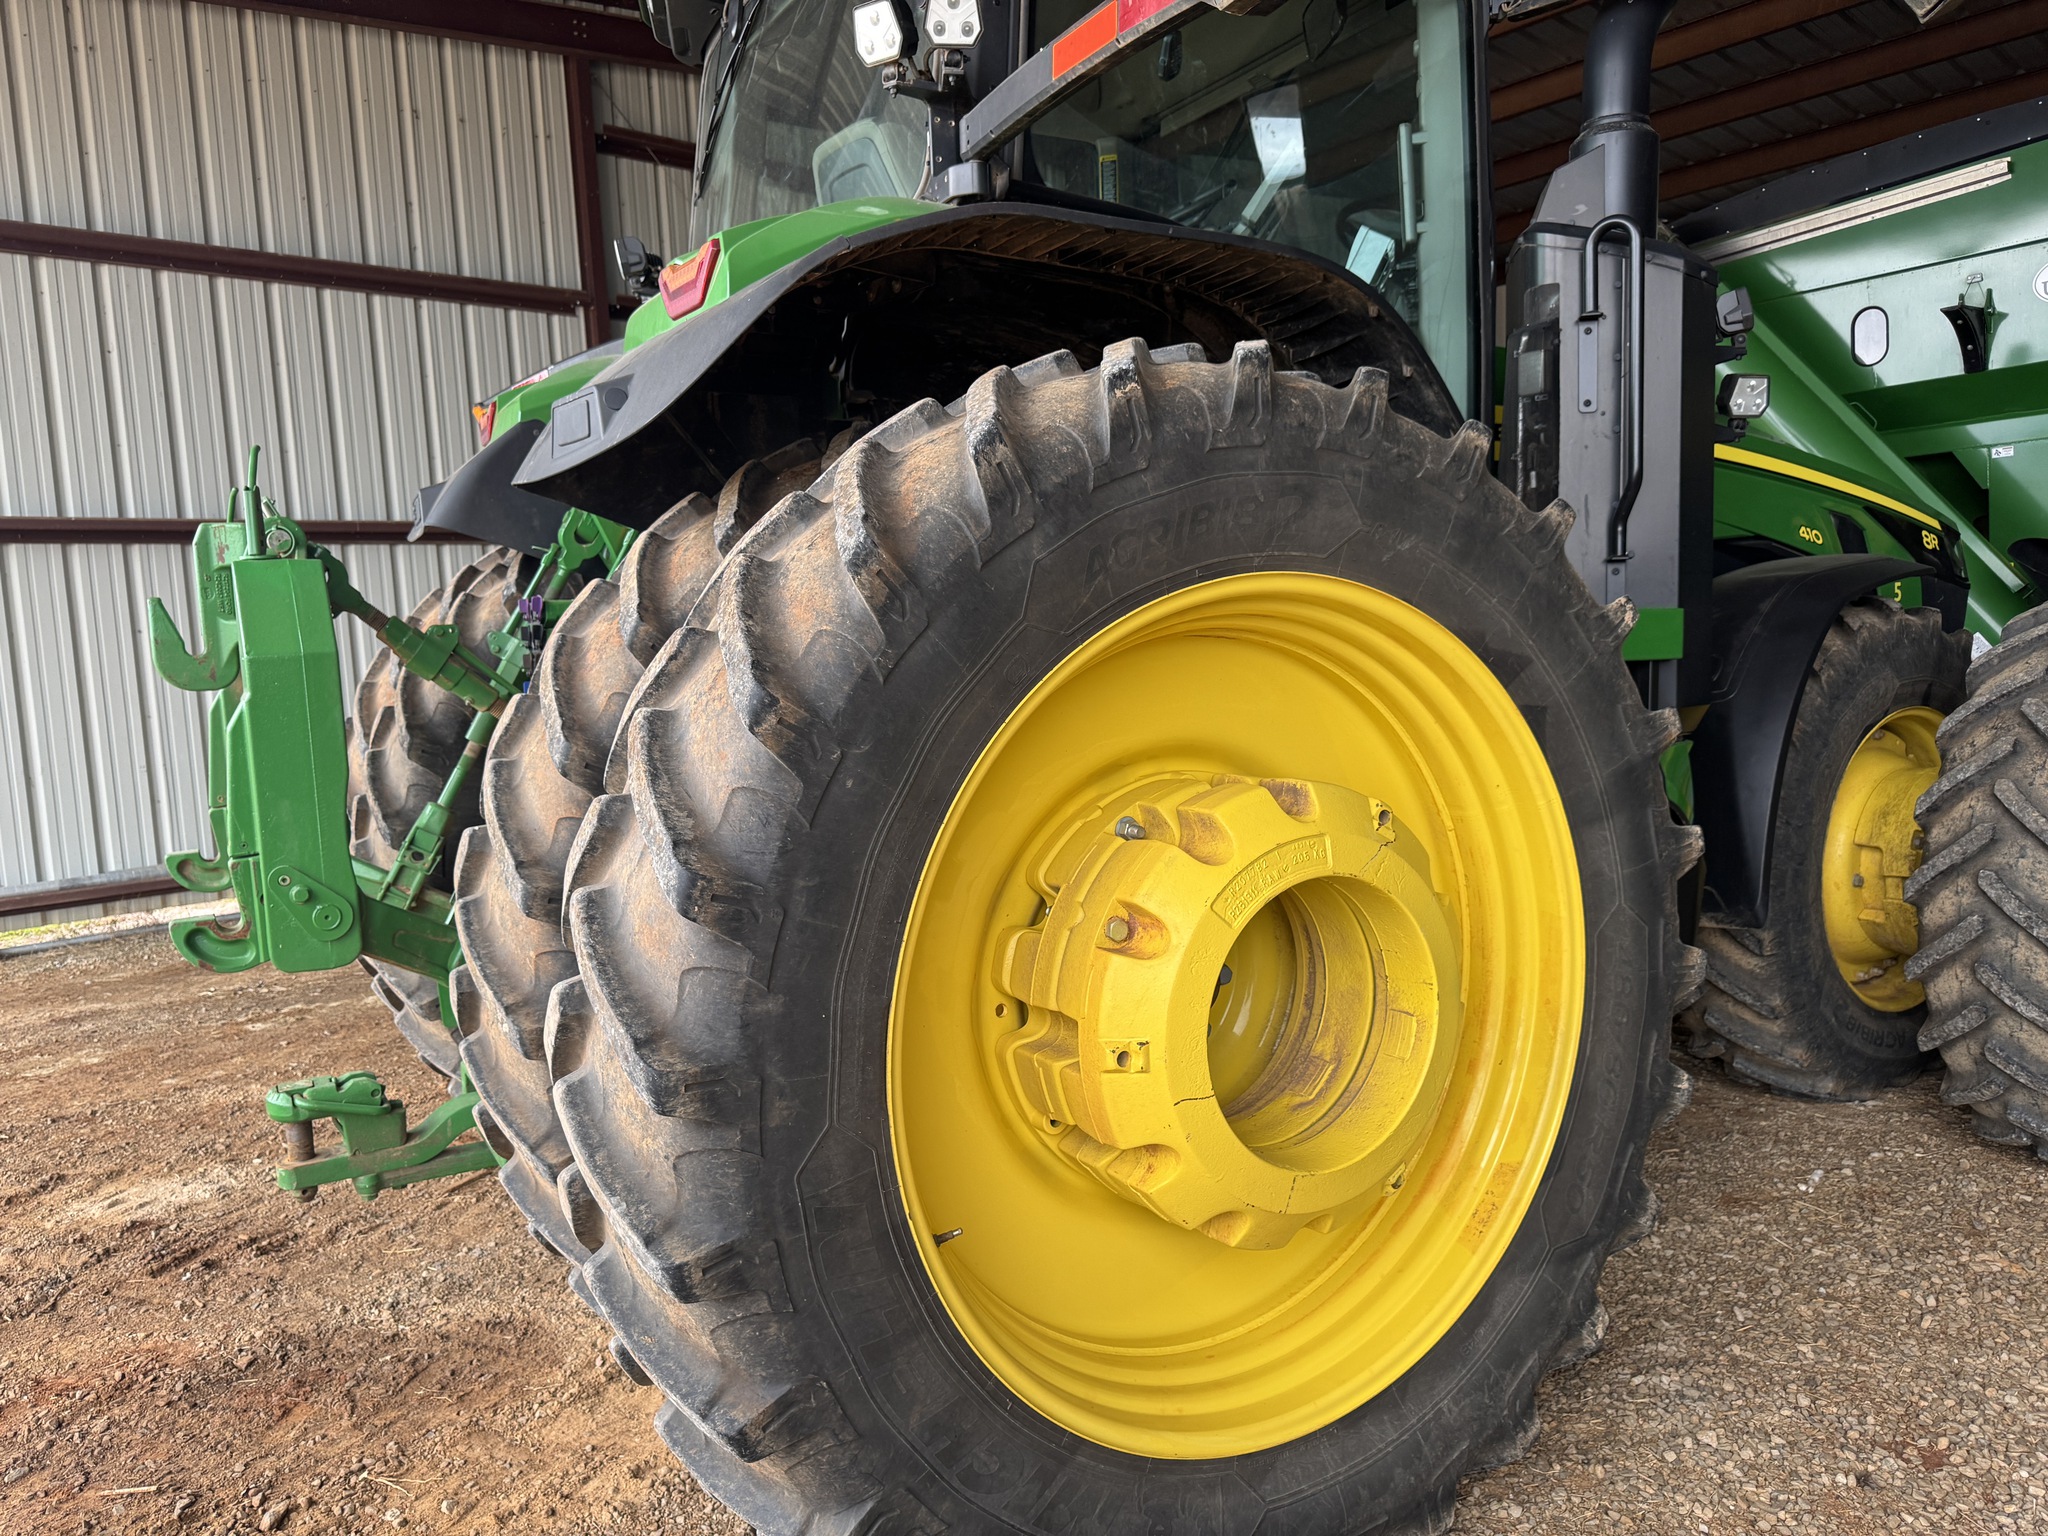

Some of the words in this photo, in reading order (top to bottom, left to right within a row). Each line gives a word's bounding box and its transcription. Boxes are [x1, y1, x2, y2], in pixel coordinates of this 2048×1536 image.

[1083, 497, 1260, 592] AGRIBIB
[1799, 526, 1824, 545] 410
[1921, 529, 1940, 551] 8R
[1893, 581, 1902, 602] 5
